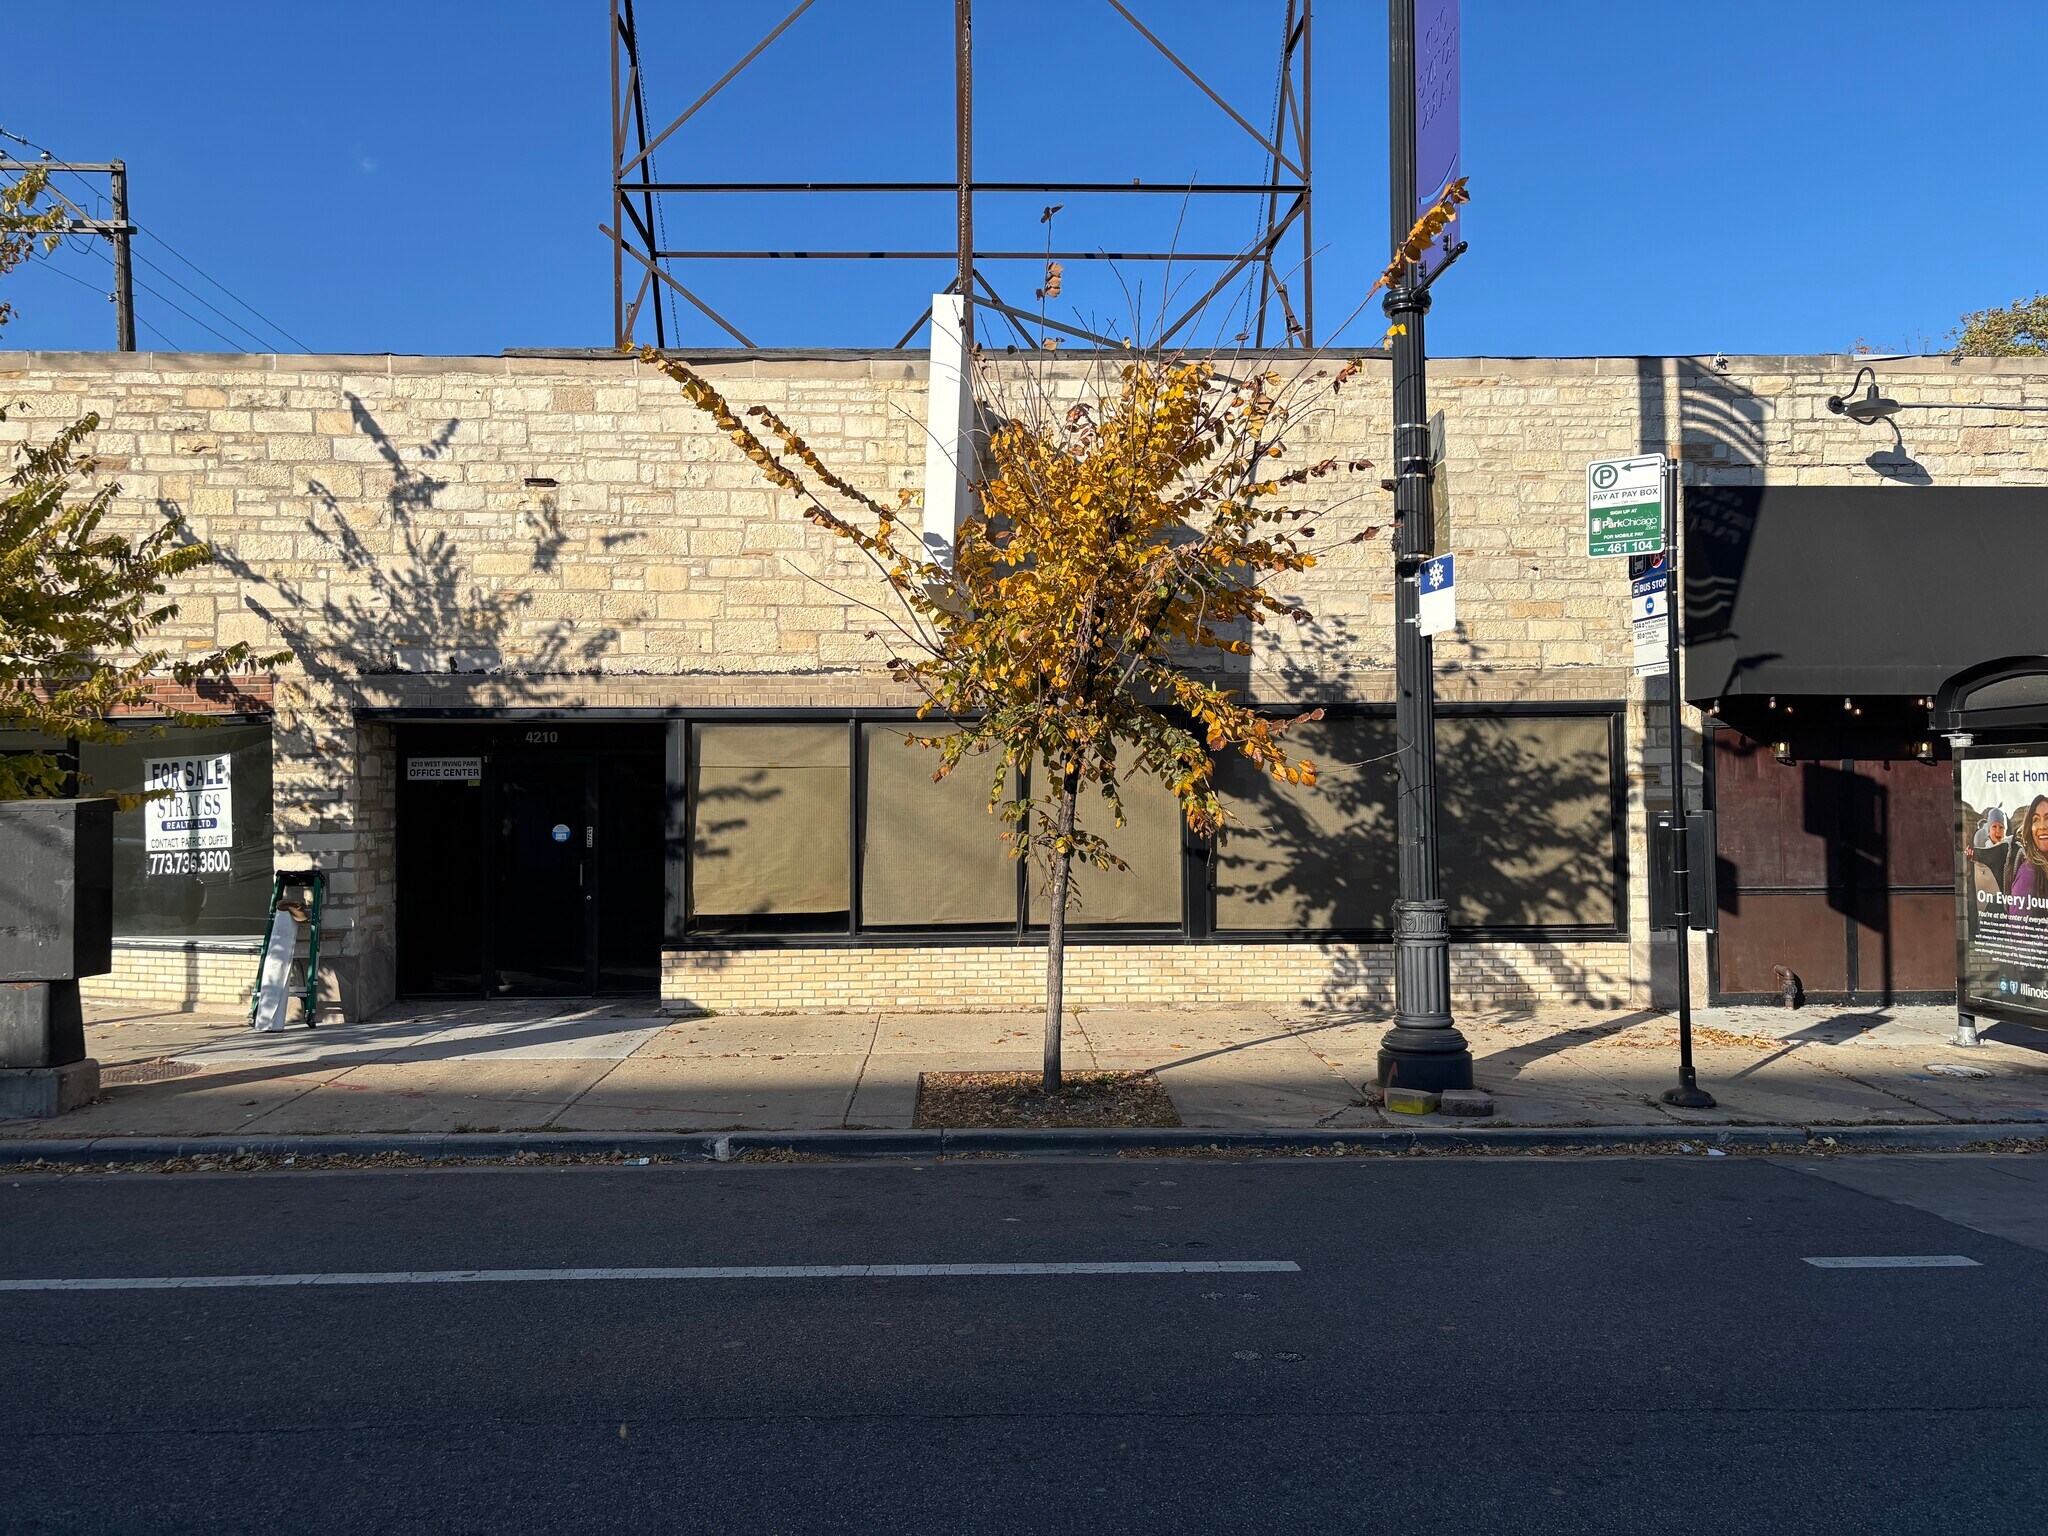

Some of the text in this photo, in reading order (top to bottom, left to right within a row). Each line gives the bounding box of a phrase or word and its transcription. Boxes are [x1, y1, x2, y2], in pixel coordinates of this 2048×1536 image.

[1609, 492, 1619, 500] AT
[1622, 490, 1637, 498] PAY
[1640, 488, 1658, 496] BOX
[1607, 543, 1628, 554] 461
[1632, 541, 1653, 551] 104
[1640, 578, 1667, 592] BUS STOP
[525, 731, 558, 743] 4210
[152, 759, 224, 790] FOR SALE
[409, 768, 480, 777] OFFICE CENTER
[1986, 770, 2006, 783] Feel
[2009, 771, 2019, 782] at
[157, 793, 221, 818] STRAUSS
[197, 820, 214, 828] LTD.
[151, 834, 228, 848] CONTACT PATRICK DUFFY
[149, 850, 231, 874] 773.736.3600
[1977, 890, 1993, 903] On
[1996, 892, 2025, 909] Every
[2023, 915, 2029, 923] of
[2021, 983, 2048, 999] Illinois
